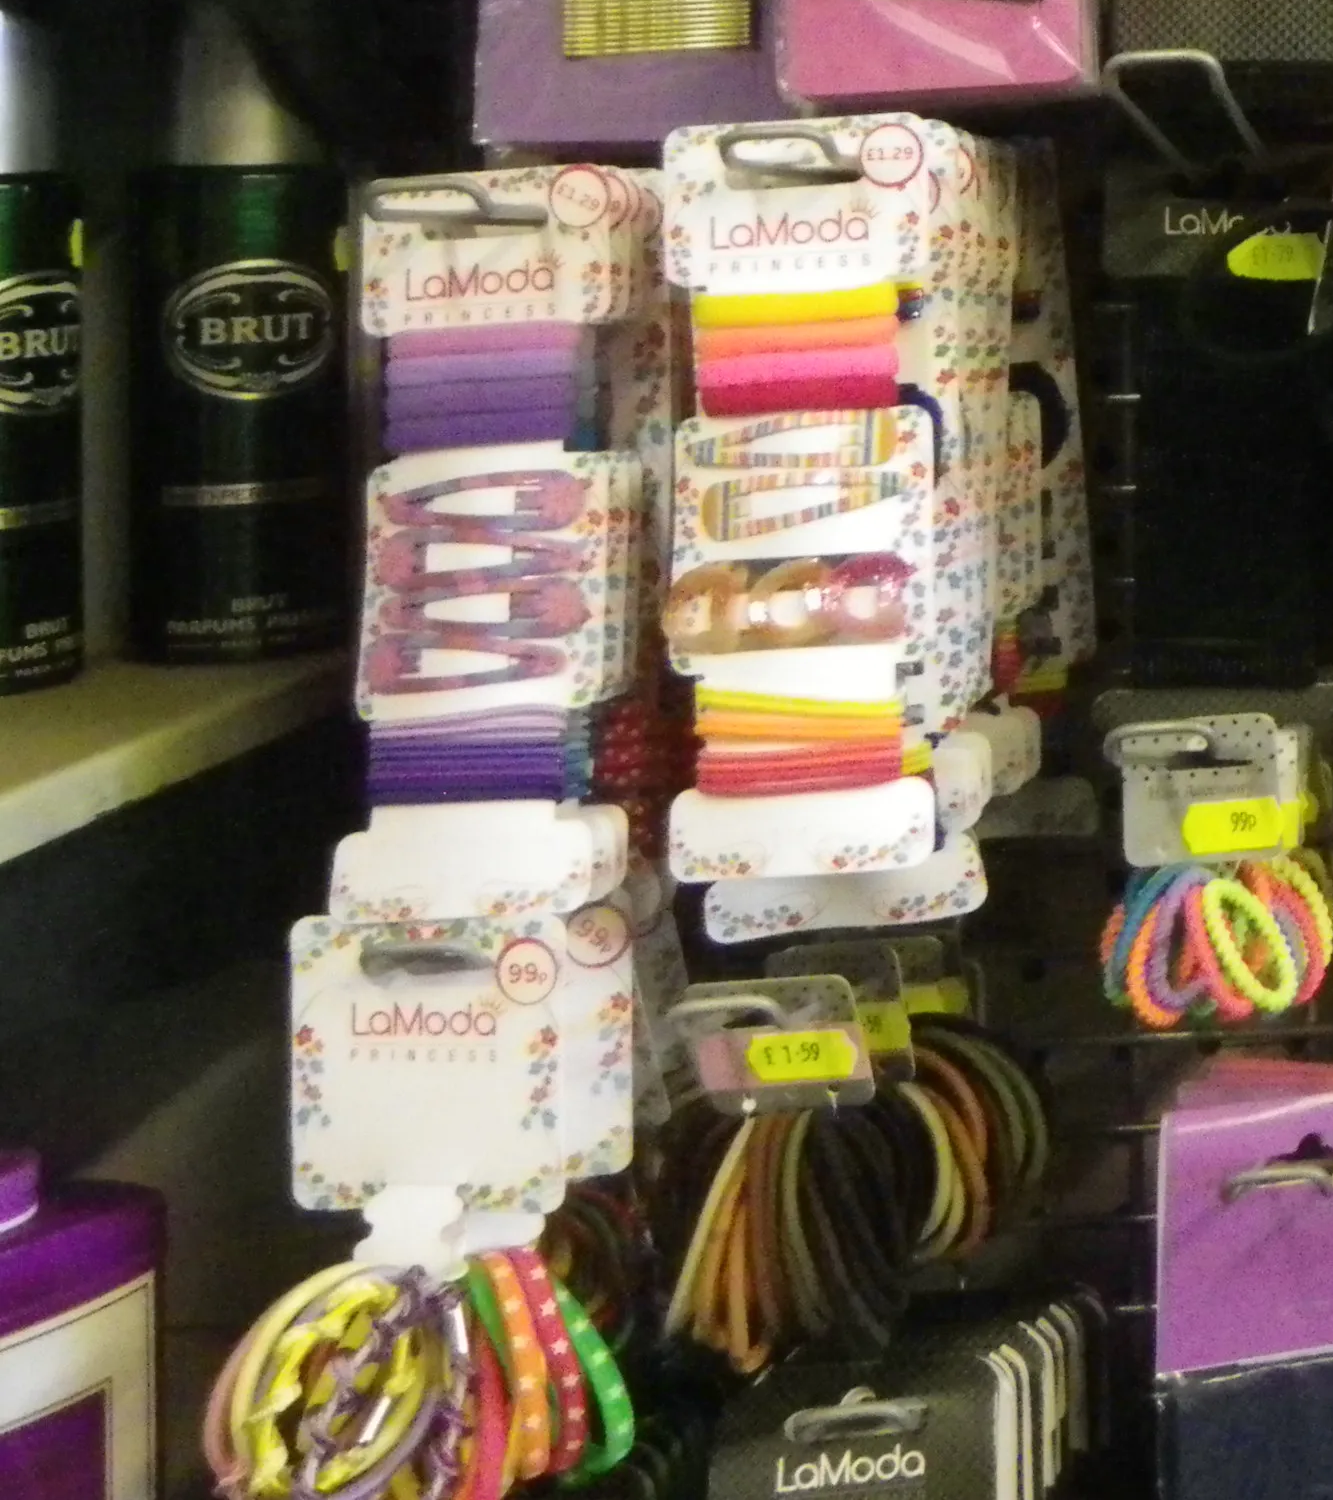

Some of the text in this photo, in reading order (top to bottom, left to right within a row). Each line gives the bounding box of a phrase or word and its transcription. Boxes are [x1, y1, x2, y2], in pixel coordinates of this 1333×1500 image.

[865, 145, 915, 163] £1.29
[708, 210, 870, 252] LaModa
[708, 252, 873, 275] PRINCESS
[404, 258, 556, 302] LaModa
[404, 303, 558, 325] PRINCESS
[200, 311, 314, 346] BRUT
[1229, 811, 1257, 833] 99p
[507, 962, 548, 986] 99p
[351, 1001, 498, 1038] LaModa
[350, 1048, 499, 1062] PRINCESS
[775, 1446, 926, 1493] LaModa
